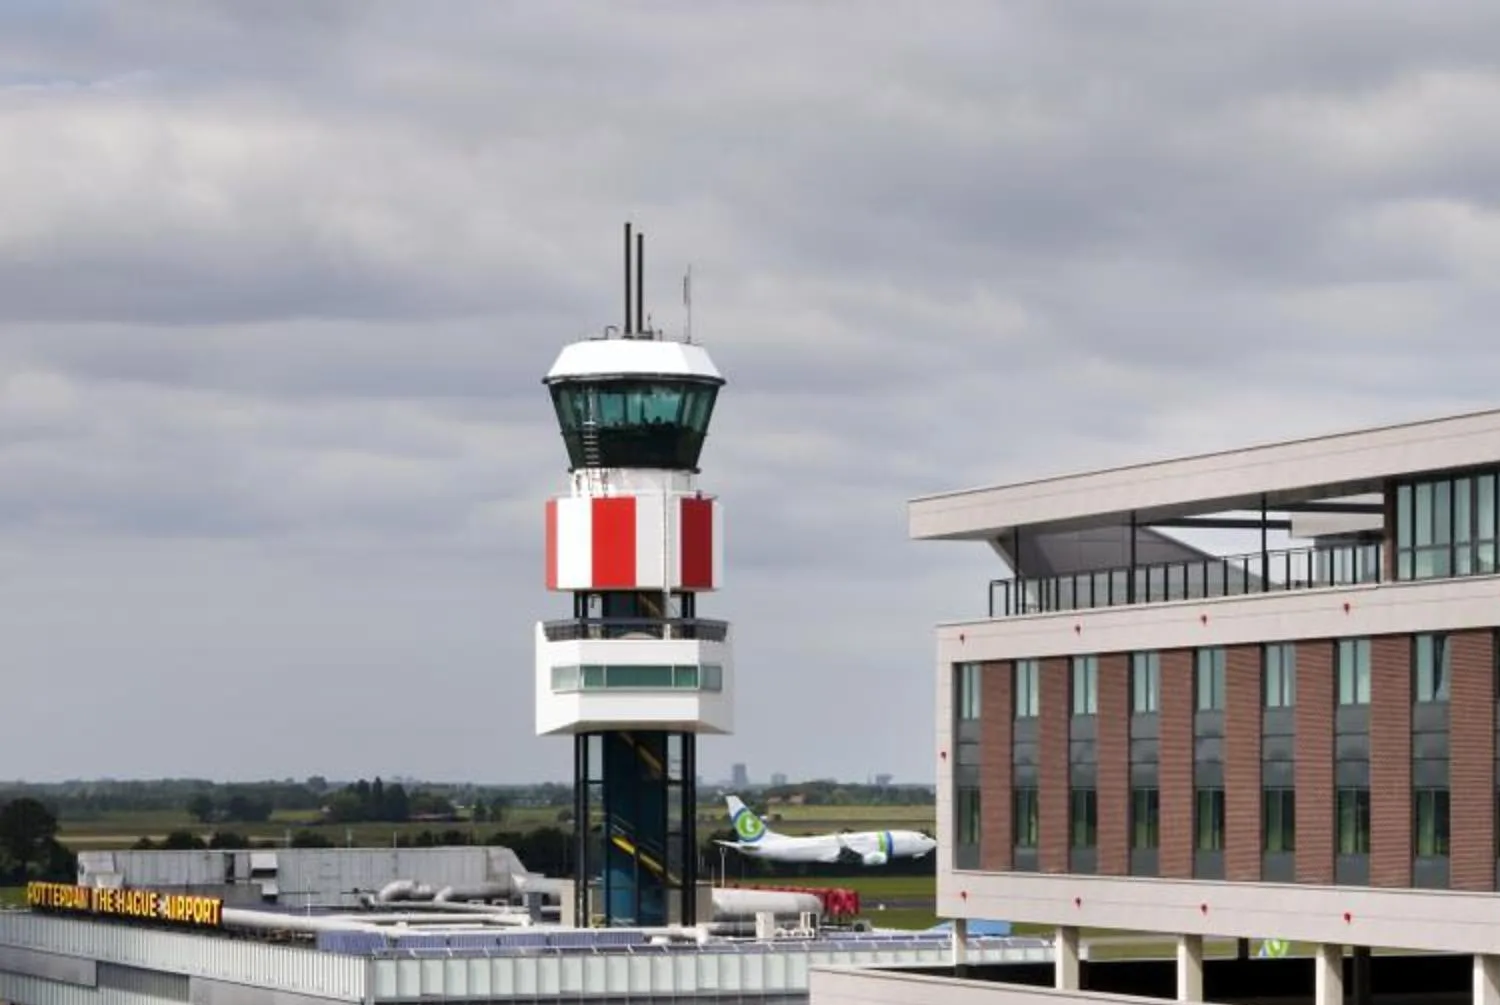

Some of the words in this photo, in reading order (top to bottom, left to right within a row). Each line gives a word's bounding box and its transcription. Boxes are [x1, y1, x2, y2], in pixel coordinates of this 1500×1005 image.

[92, 887, 115, 912] THE
[116, 890, 157, 917] HAGUE
[164, 896, 220, 924] AIRPORT
